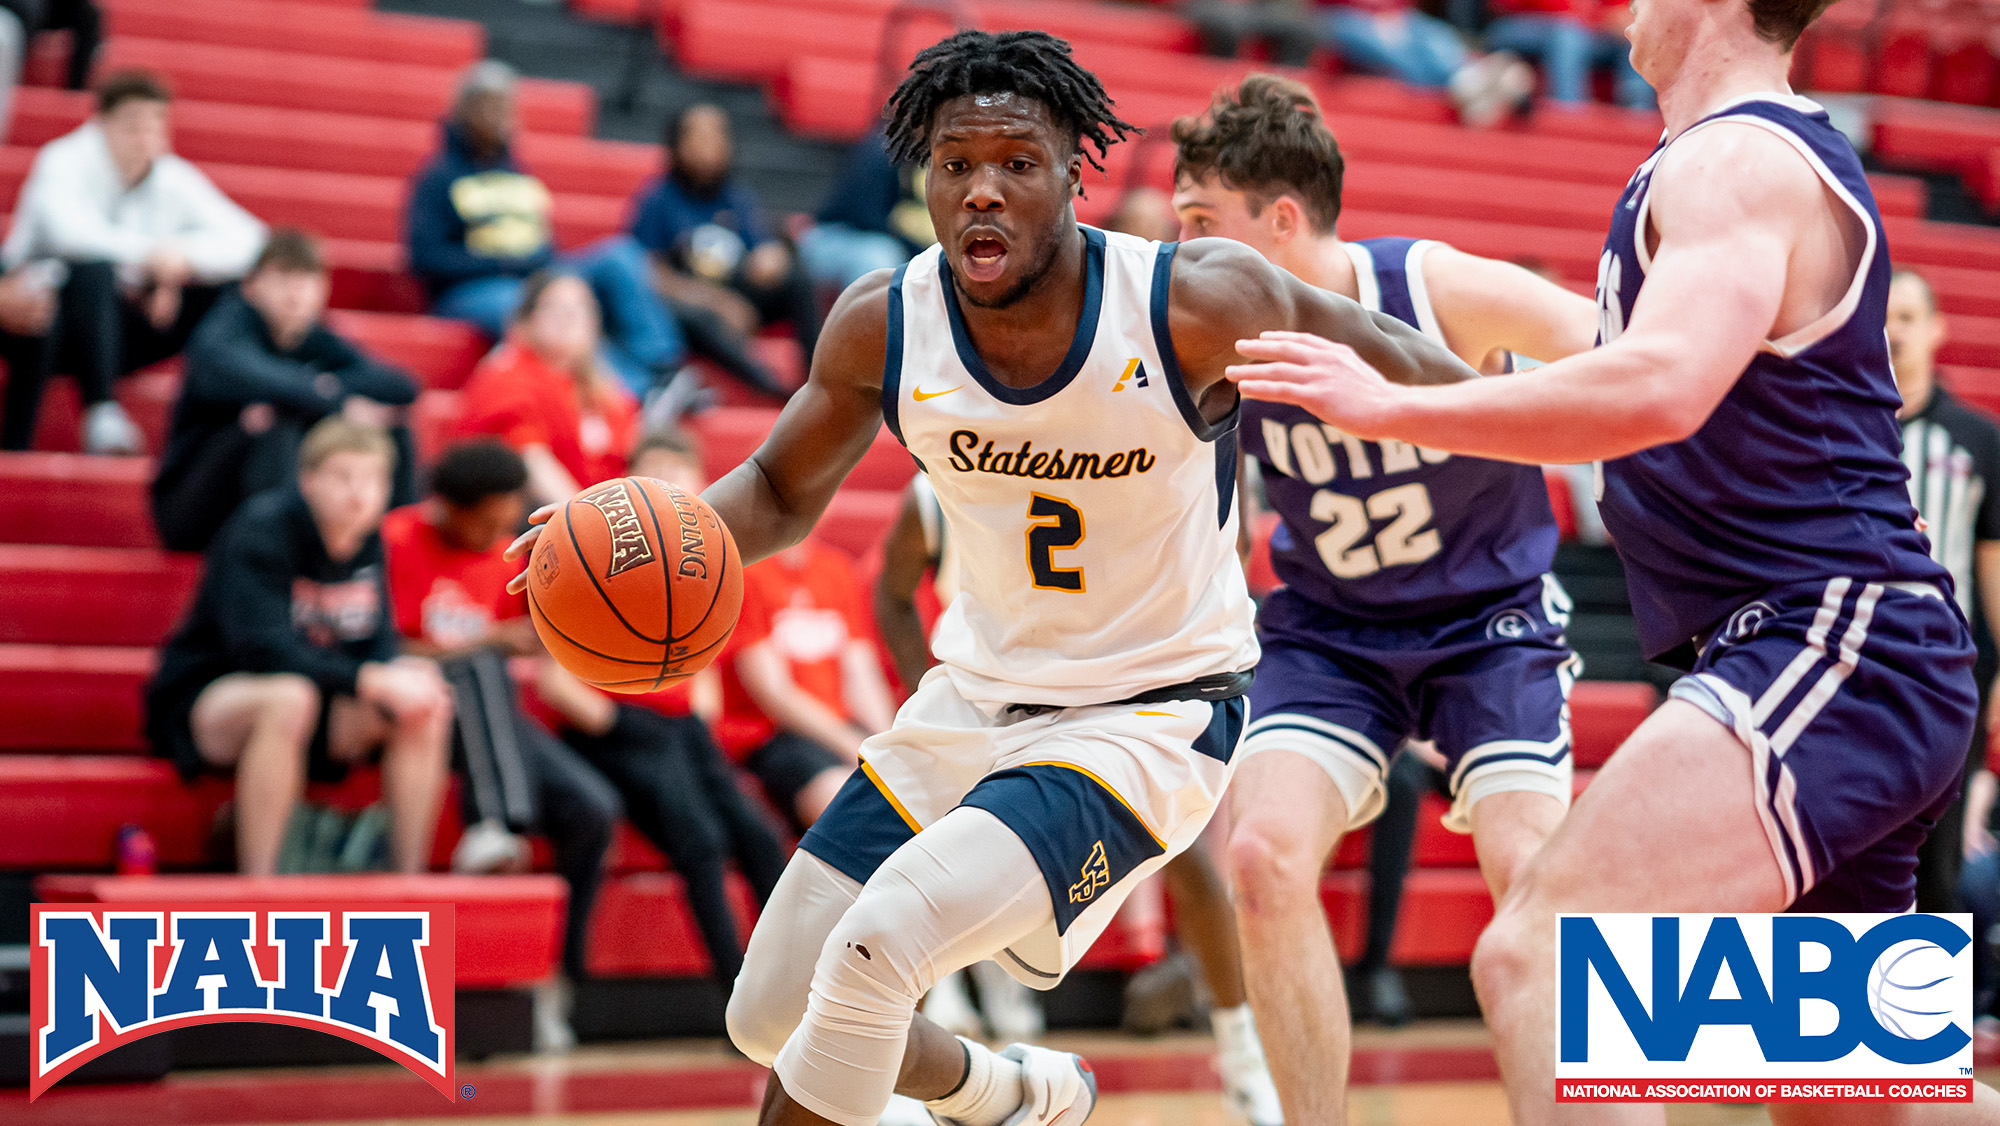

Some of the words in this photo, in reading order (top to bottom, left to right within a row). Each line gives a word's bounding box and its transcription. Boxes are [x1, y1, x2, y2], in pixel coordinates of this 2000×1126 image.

[948, 430, 1155, 480] Statesmen
[577, 484, 653, 575] NAIA
[654, 481, 707, 580] ALDING
[1025, 491, 1086, 593] 2
[1309, 482, 1442, 579] 22
